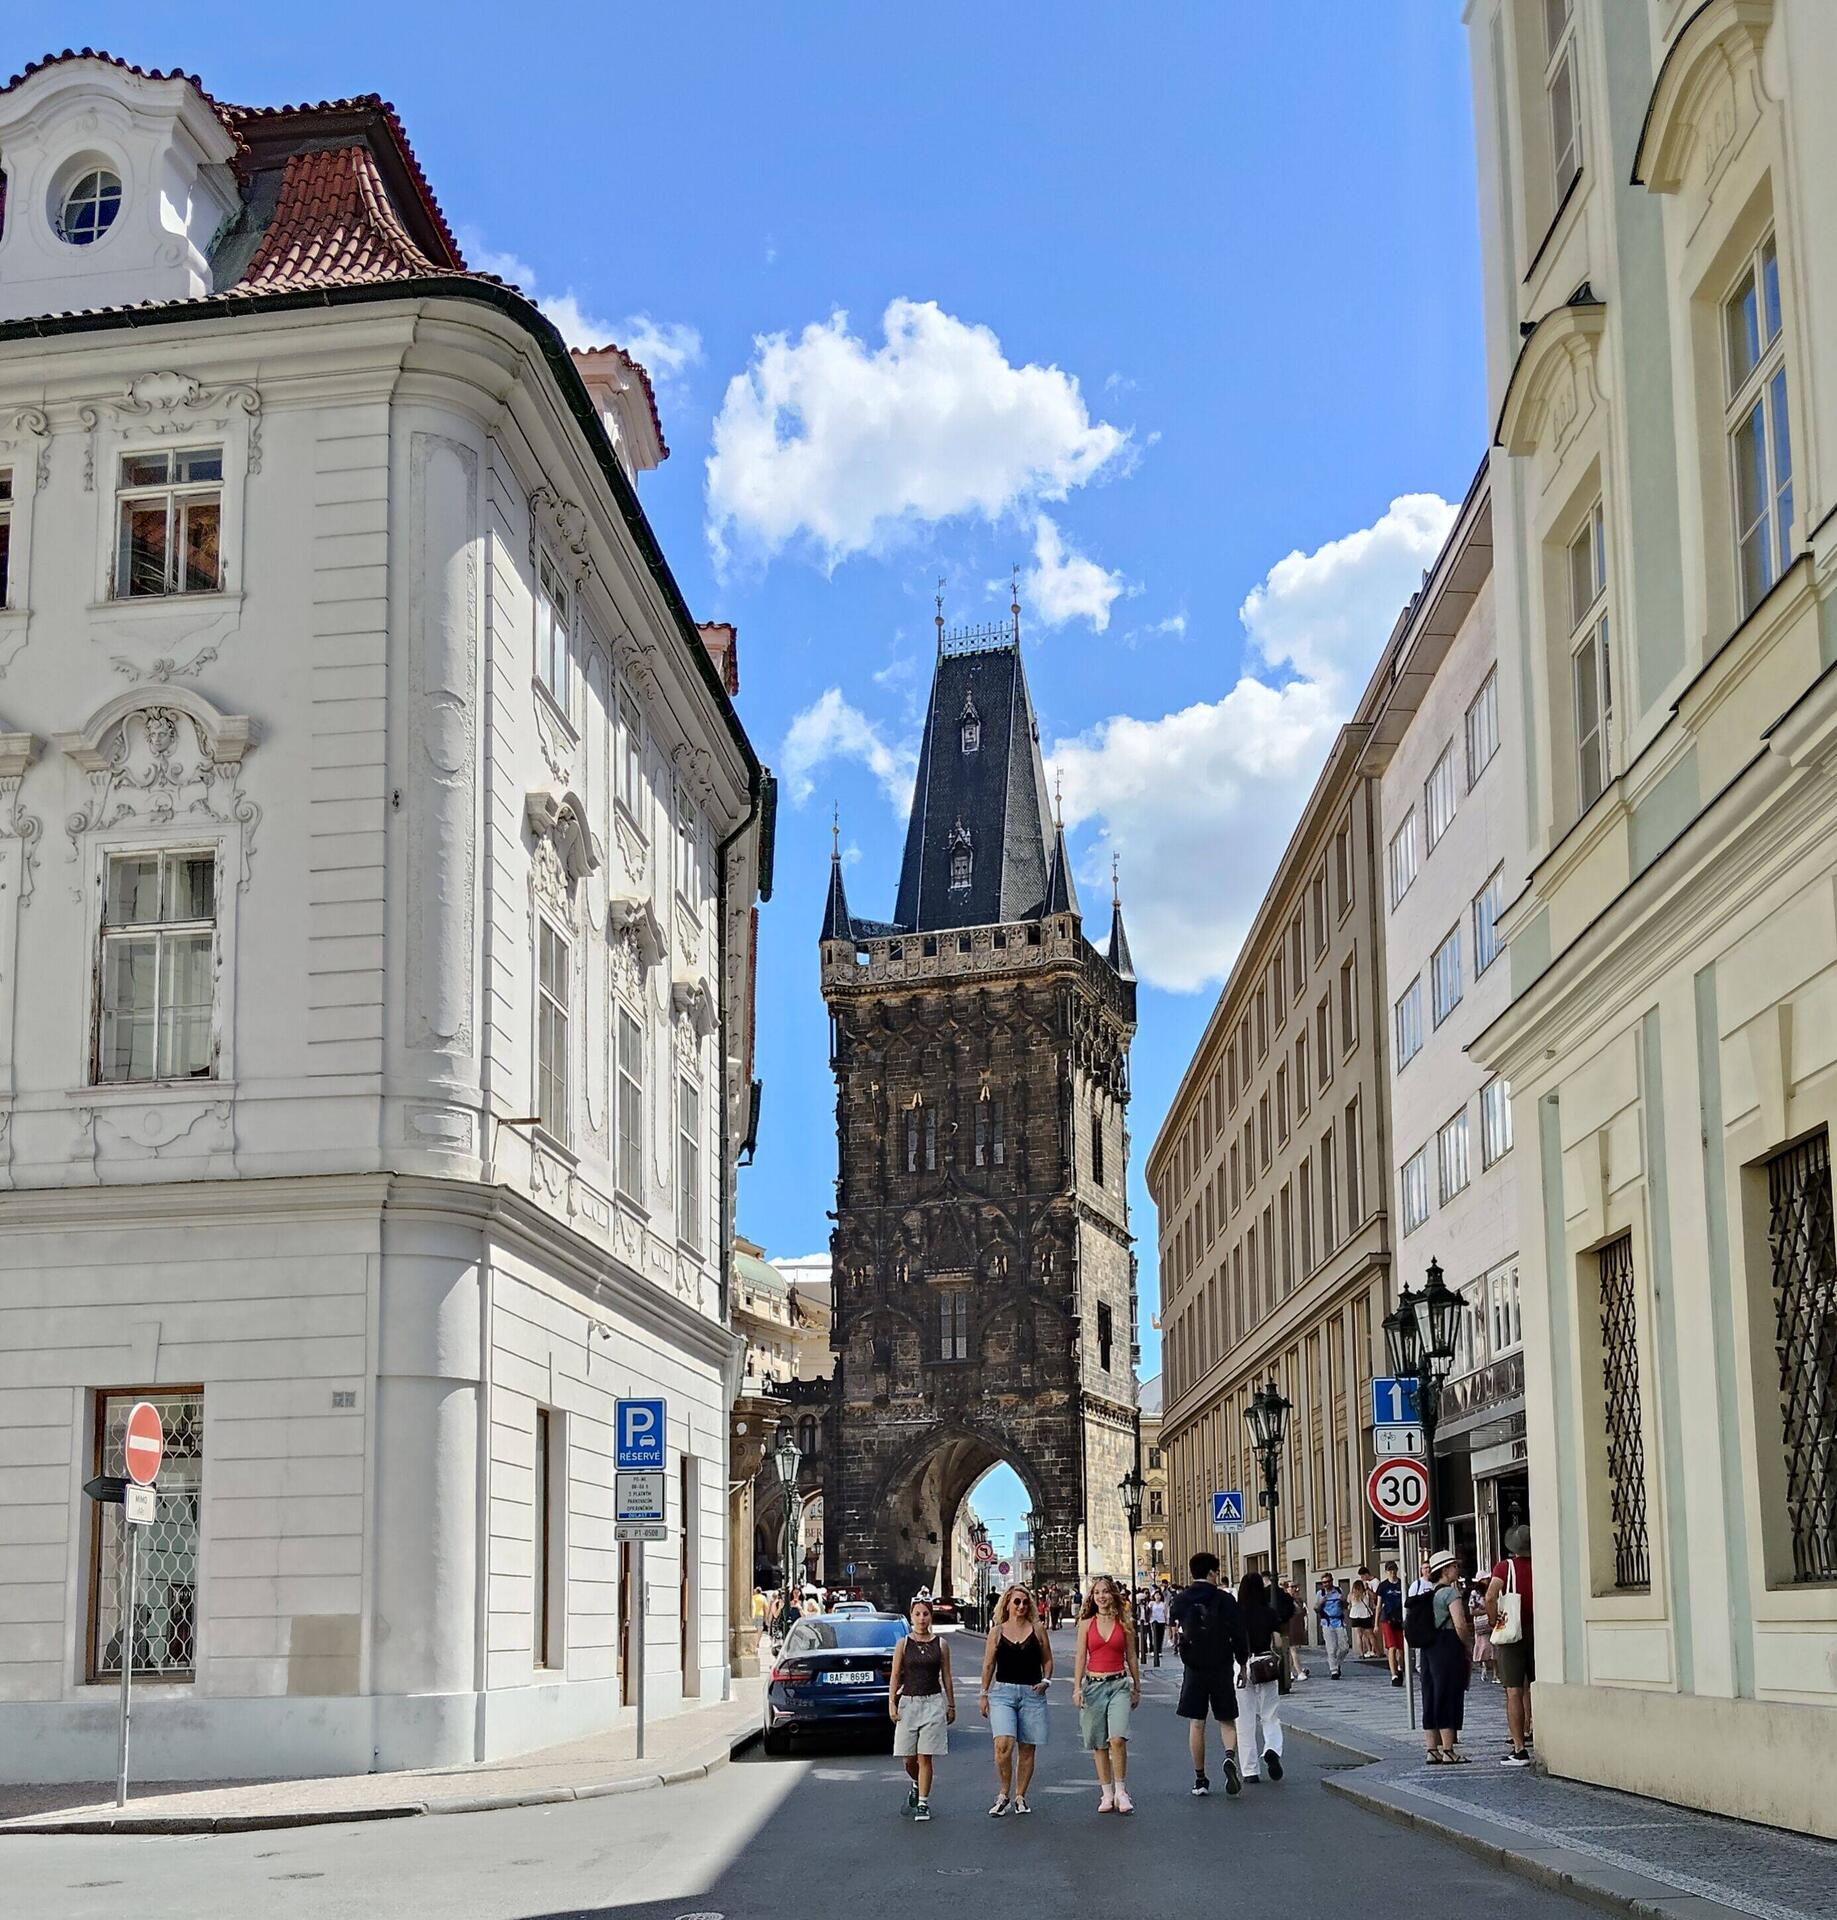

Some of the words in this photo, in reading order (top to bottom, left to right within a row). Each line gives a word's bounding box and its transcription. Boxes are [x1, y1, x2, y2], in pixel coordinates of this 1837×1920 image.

[626, 1407, 654, 1448] P
[135, 1494, 148, 1505] MIMO
[1381, 1475, 1421, 1507] 30
[829, 1673, 844, 1682] 8AF
[850, 1672, 870, 1681] 8695
